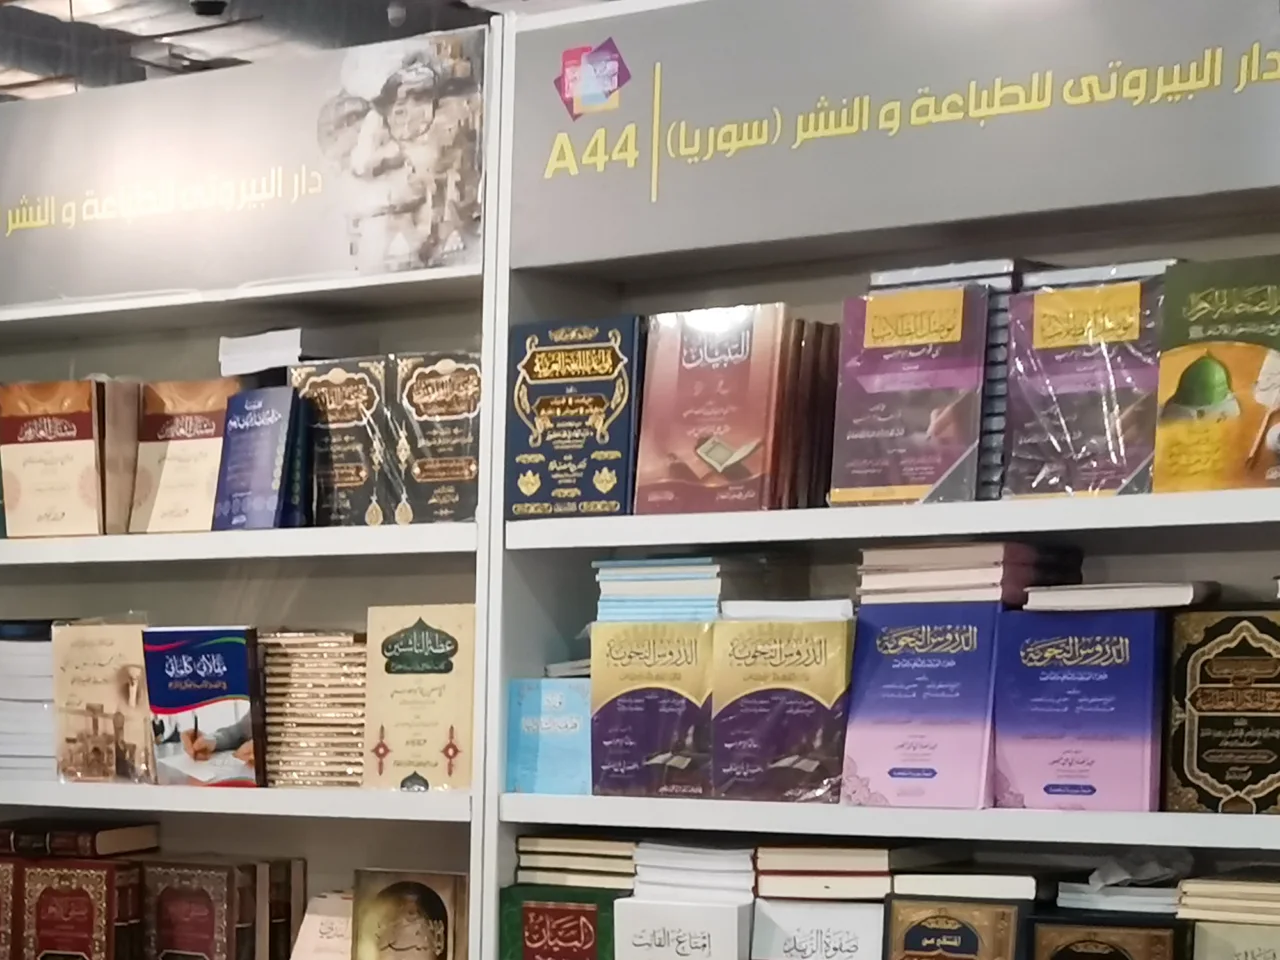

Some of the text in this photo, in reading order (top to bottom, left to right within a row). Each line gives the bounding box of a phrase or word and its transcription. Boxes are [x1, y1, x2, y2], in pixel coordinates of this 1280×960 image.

[1235, 43, 1280, 92] دار
[792, 97, 869, 149] النشر
[879, 102, 900, 136] و
[910, 72, 1054, 129] للطباعة
[544, 124, 640, 180] A44
[666, 107, 782, 165] (سوريا)
[291, 164, 322, 204] دار
[5, 196, 56, 237] النشر
[62, 201, 76, 229] و
[524, 911, 596, 952] البيان
